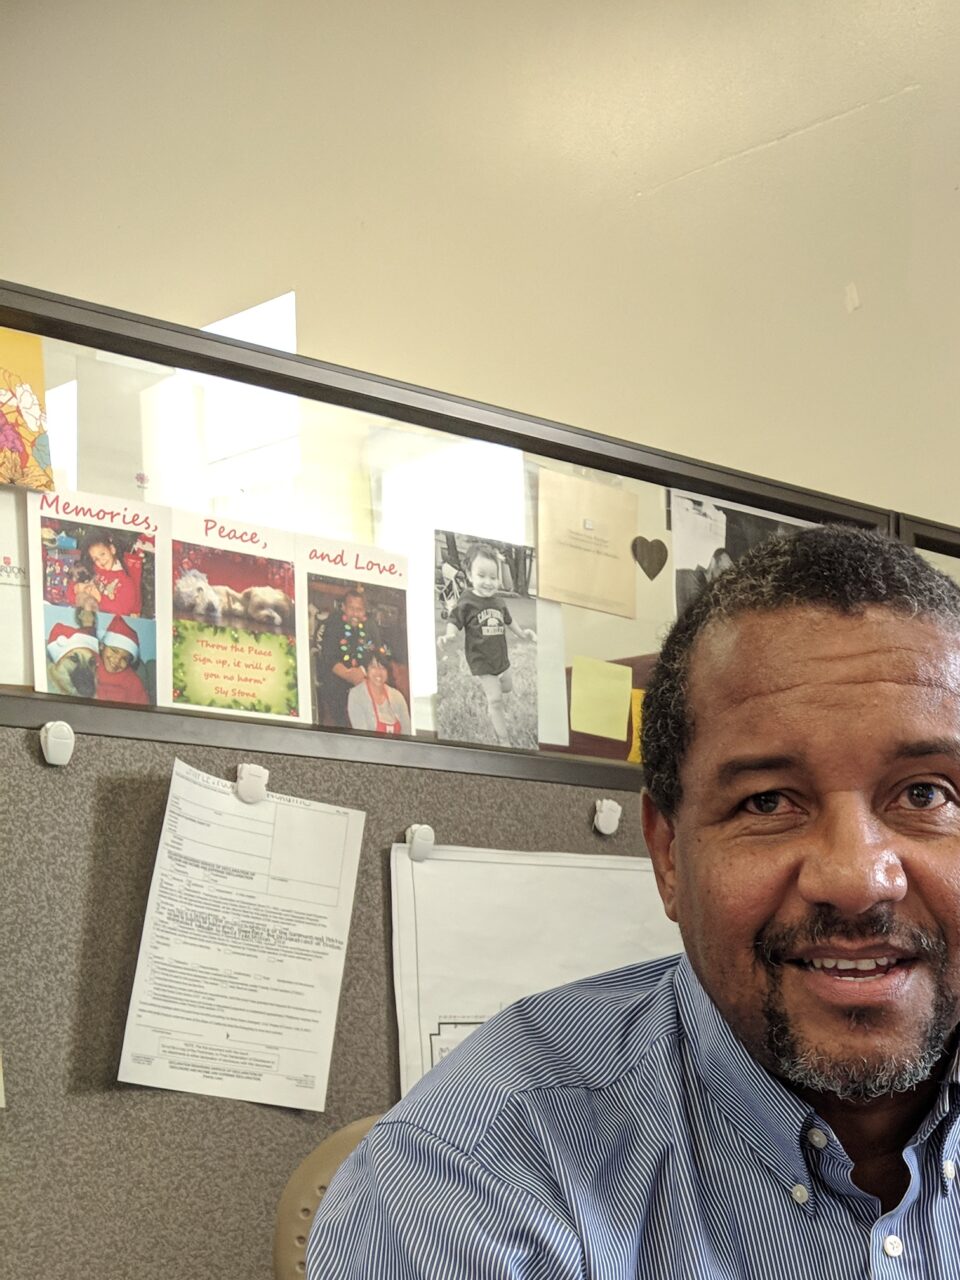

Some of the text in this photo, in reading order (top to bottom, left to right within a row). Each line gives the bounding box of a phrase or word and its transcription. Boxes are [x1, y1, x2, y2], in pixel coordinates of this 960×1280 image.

[40, 494, 403, 577] Memories, Peace, and Love.
[231, 643, 244, 654] the
[248, 646, 272, 657] Peace
[193, 654, 212, 665] Sign
[233, 659, 241, 668] it
[244, 661, 263, 671] will
[265, 663, 276, 672] do
[203, 672, 220, 680] you
[214, 686, 257, 699] Sly Stone
